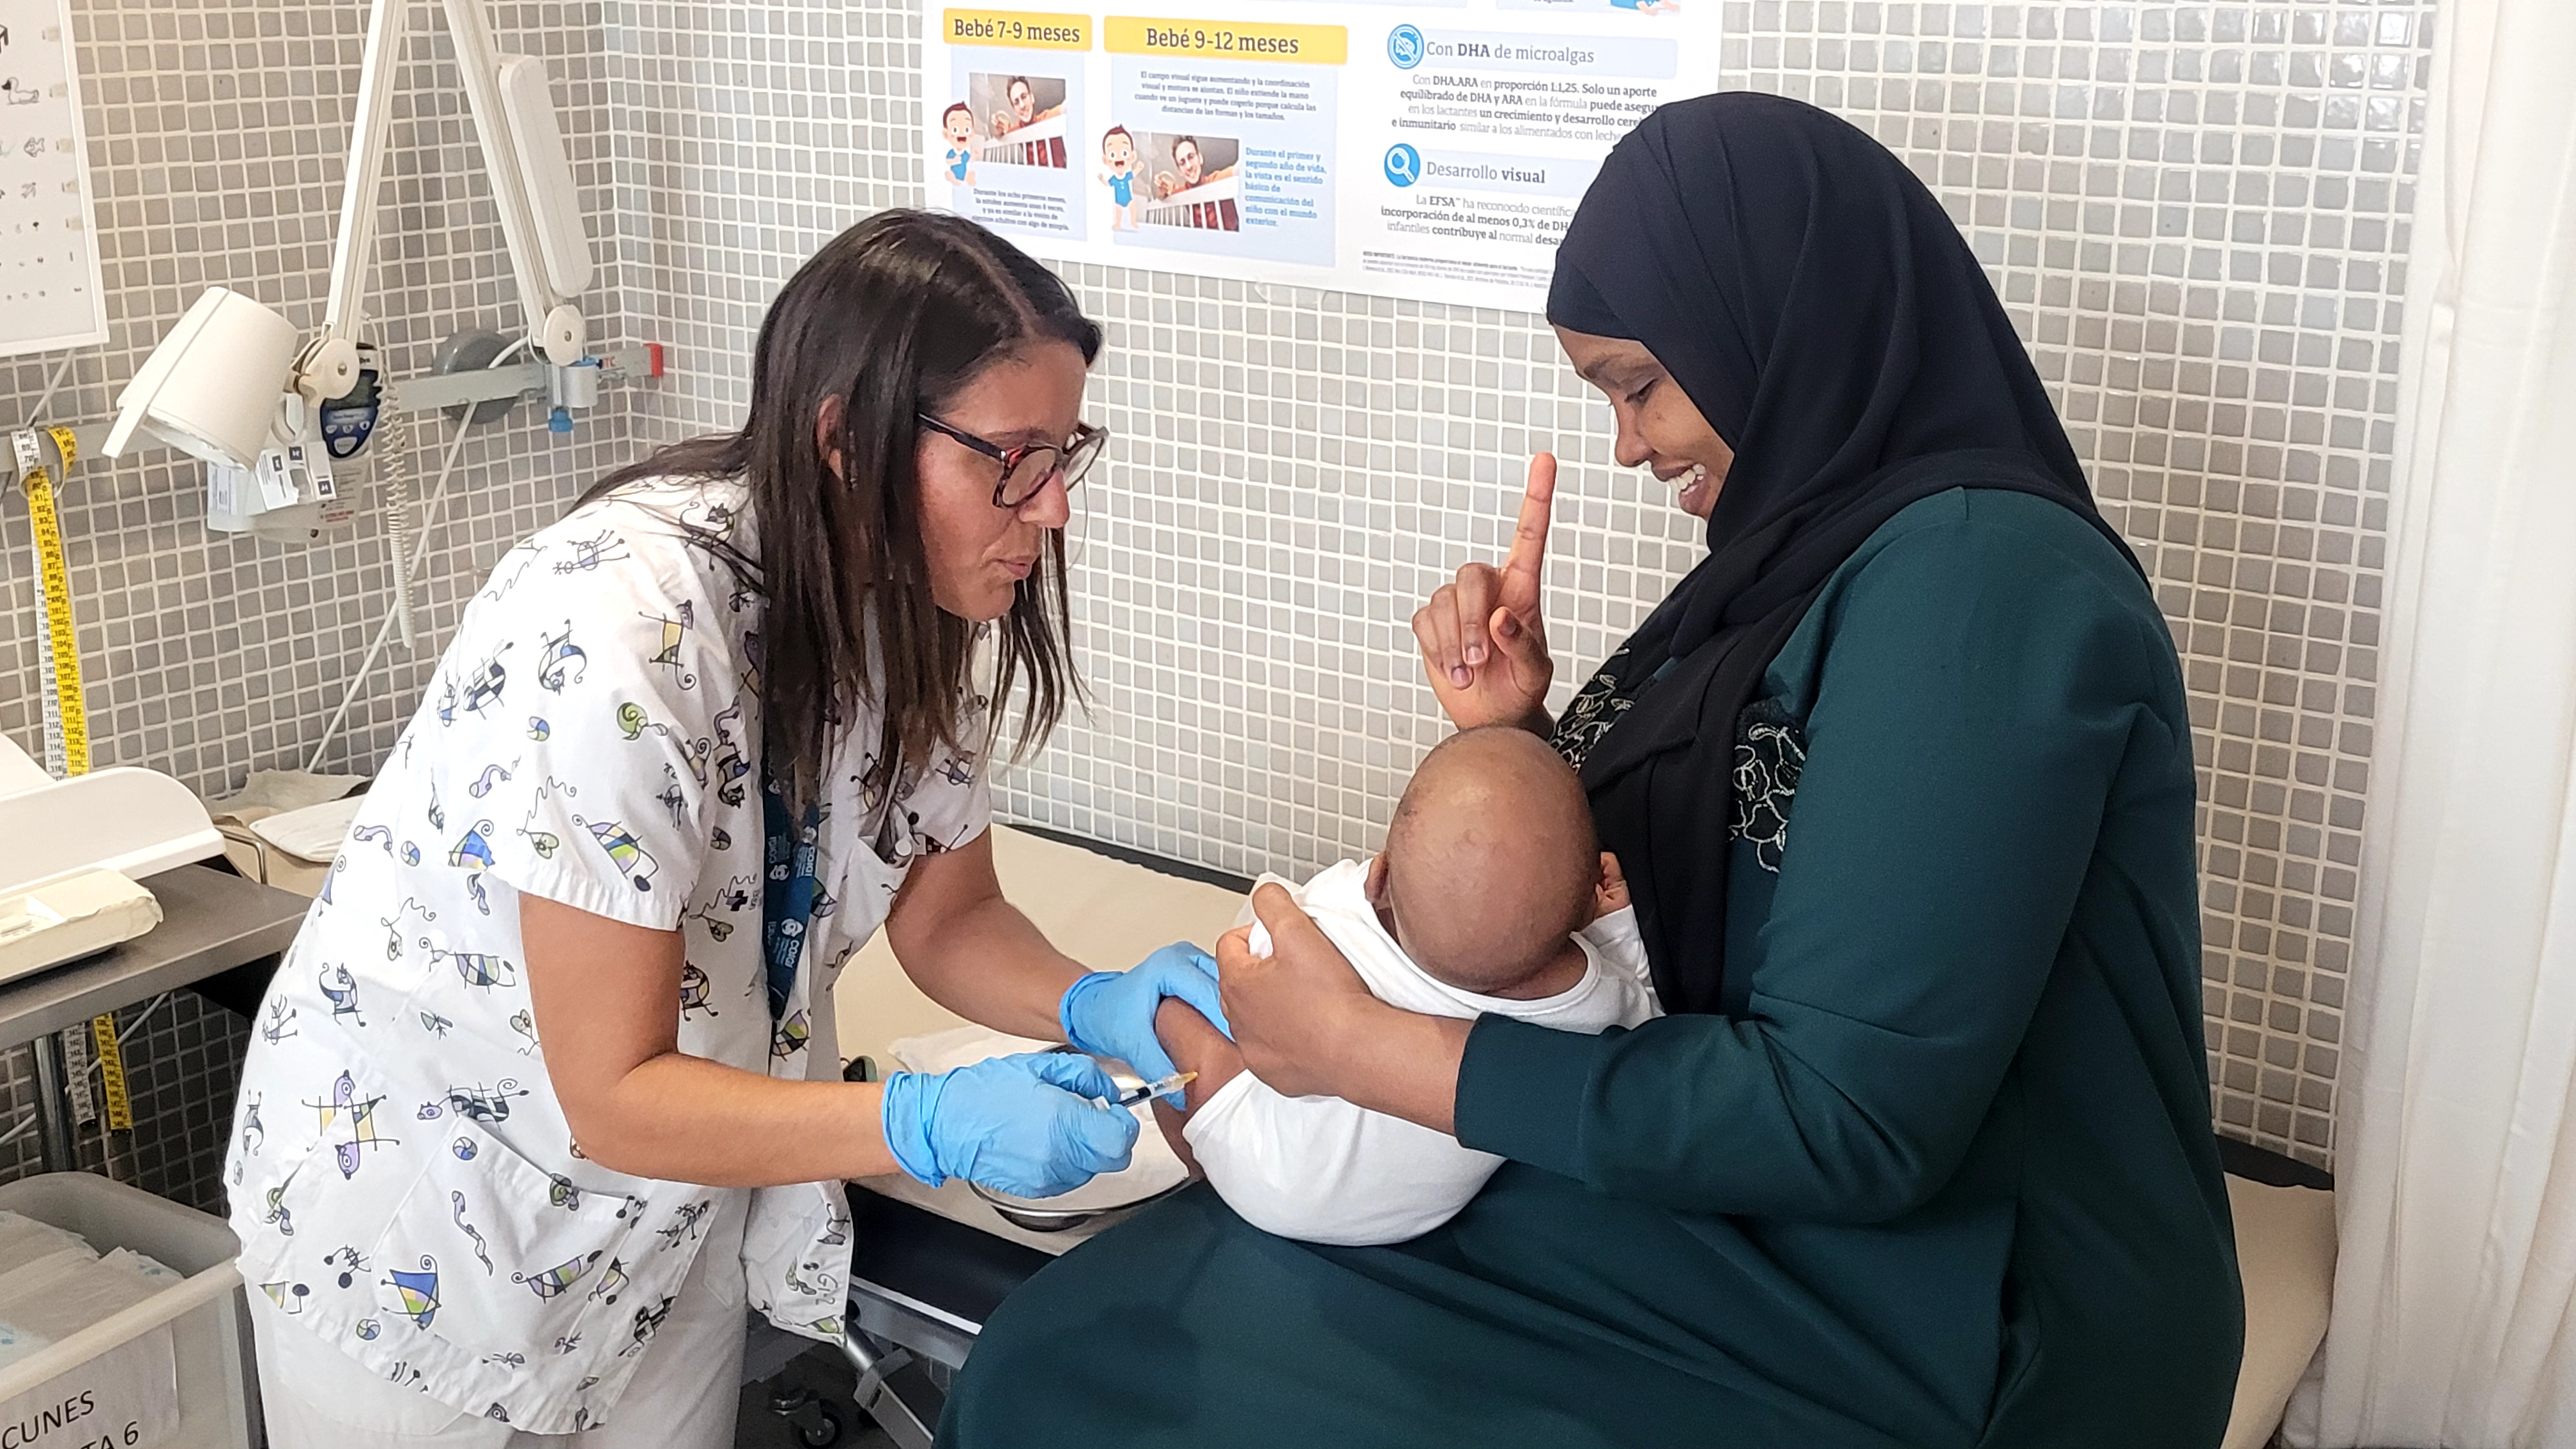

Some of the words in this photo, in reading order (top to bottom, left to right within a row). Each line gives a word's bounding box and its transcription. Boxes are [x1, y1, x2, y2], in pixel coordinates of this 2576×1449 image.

[954, 19, 993, 37] Bebé
[997, 20, 1022, 39] 7-9
[1027, 26, 1080, 43] meses
[1146, 28, 1190, 49] Bebé
[1194, 31, 1234, 50] 9-12
[1238, 35, 1300, 54] meses
[1426, 42, 1453, 56] Con
[1457, 43, 1490, 57] DHA
[1494, 43, 1511, 59] de
[1515, 46, 1594, 65] microalgas
[1413, 74, 1430, 84] Con
[1494, 80, 1548, 91] proporción
[1581, 83, 1604, 94] Solo
[1606, 87, 1620, 95] un
[1622, 88, 1657, 97] aporte
[1400, 89, 1454, 100] equilibrado
[1456, 91, 1468, 102] de
[1469, 92, 1492, 103] DHA
[1494, 95, 1499, 106] y
[1501, 94, 1522, 105] ARA
[1539, 96, 1547, 106] la
[1550, 96, 1587, 109] fórmula
[1590, 100, 1622, 111] puede
[1422, 104, 1434, 114] los
[1437, 105, 1477, 117] lactantes
[1494, 110, 1552, 121] crecimiento
[1554, 114, 1561, 124] y
[1562, 112, 1615, 125] desarrollo
[1391, 119, 1397, 127] e
[1399, 118, 1456, 130] inmunitario
[1460, 122, 1490, 132] similar
[1499, 123, 1512, 134] los
[1514, 125, 1572, 138] alimentados
[1574, 131, 1593, 139] con
[1427, 162, 1497, 180] Desarrollo
[1501, 167, 1545, 183] visual
[1416, 194, 1427, 204] La
[1462, 197, 1474, 208] ha
[1476, 201, 1529, 213] reconocido
[1381, 206, 1450, 220] incorporación
[1452, 211, 1464, 222] de
[1466, 213, 1475, 223] al
[1477, 216, 1510, 226] menos
[1512, 217, 1535, 229] 0,3%
[1537, 219, 1550, 230] de
[1387, 221, 1430, 233] infantiles
[1432, 227, 1486, 240] contribuye
[1488, 229, 1497, 240] al
[1499, 233, 1533, 243] normal
[124, 1421, 139, 1446] 6
